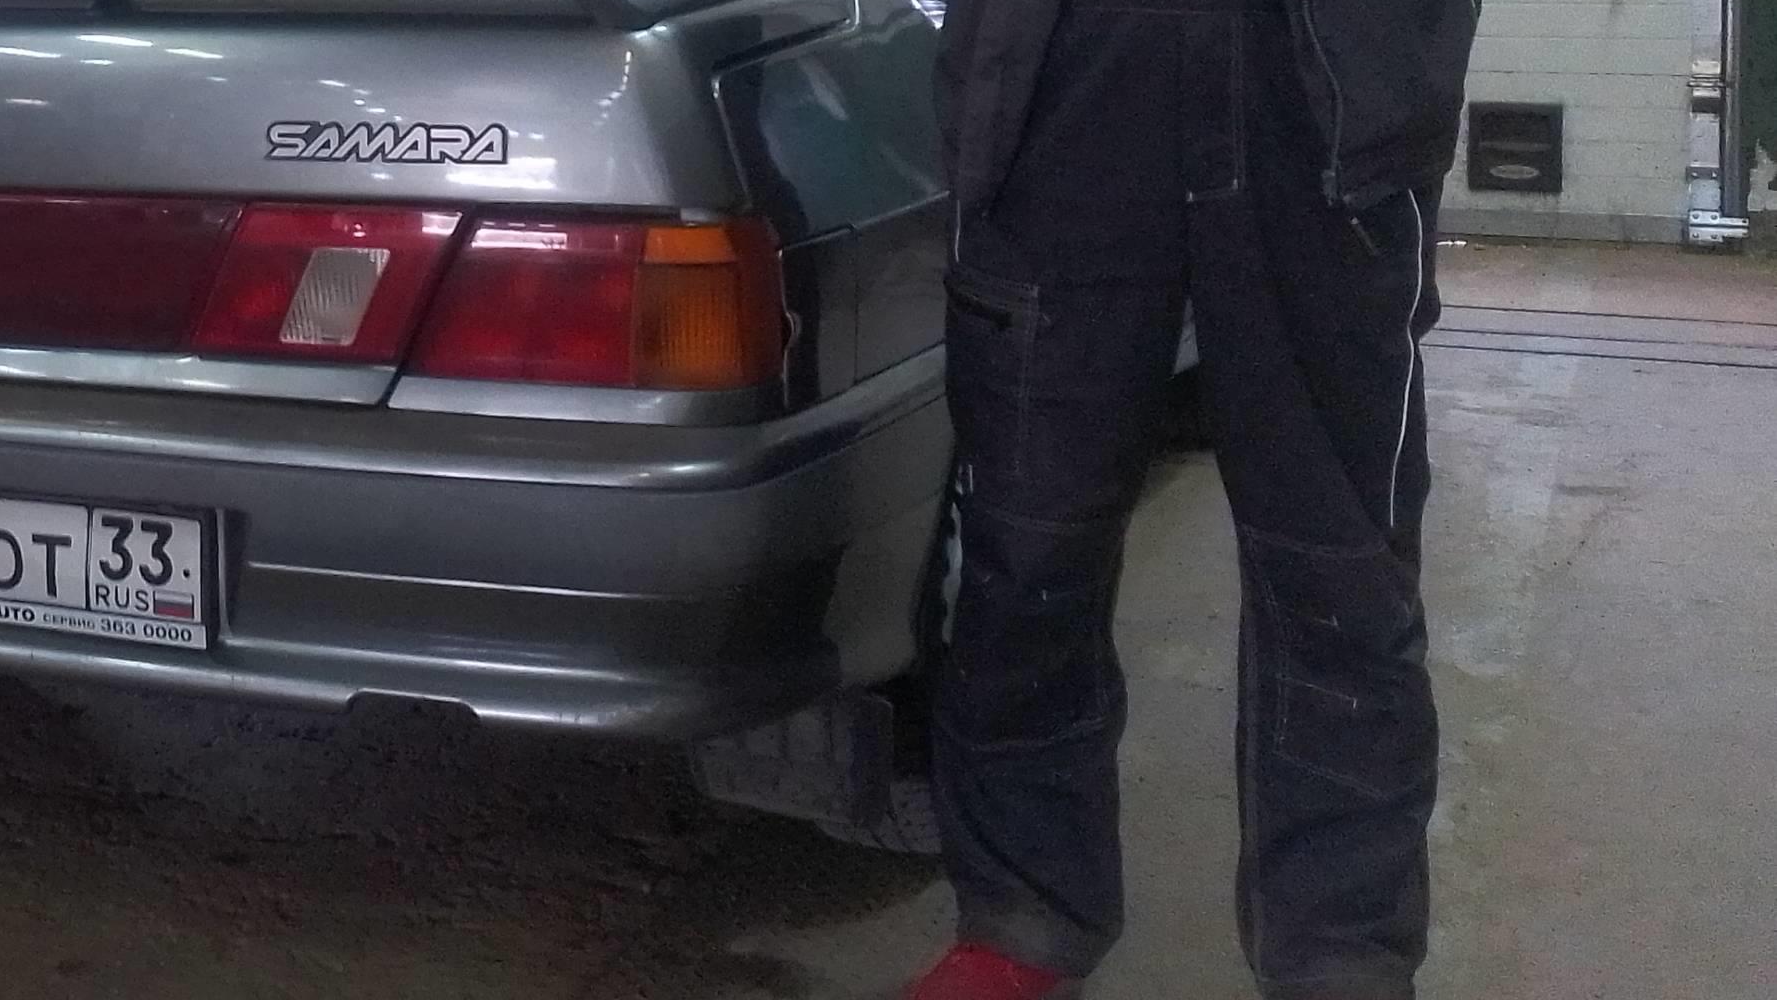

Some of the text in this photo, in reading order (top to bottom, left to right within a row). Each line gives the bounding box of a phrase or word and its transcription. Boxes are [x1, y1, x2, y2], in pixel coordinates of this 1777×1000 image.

[264, 121, 509, 164] SAMARA
[99, 515, 174, 586] 33
[94, 584, 150, 613] RUS
[100, 617, 137, 636] 363
[143, 625, 193, 643] 0000
